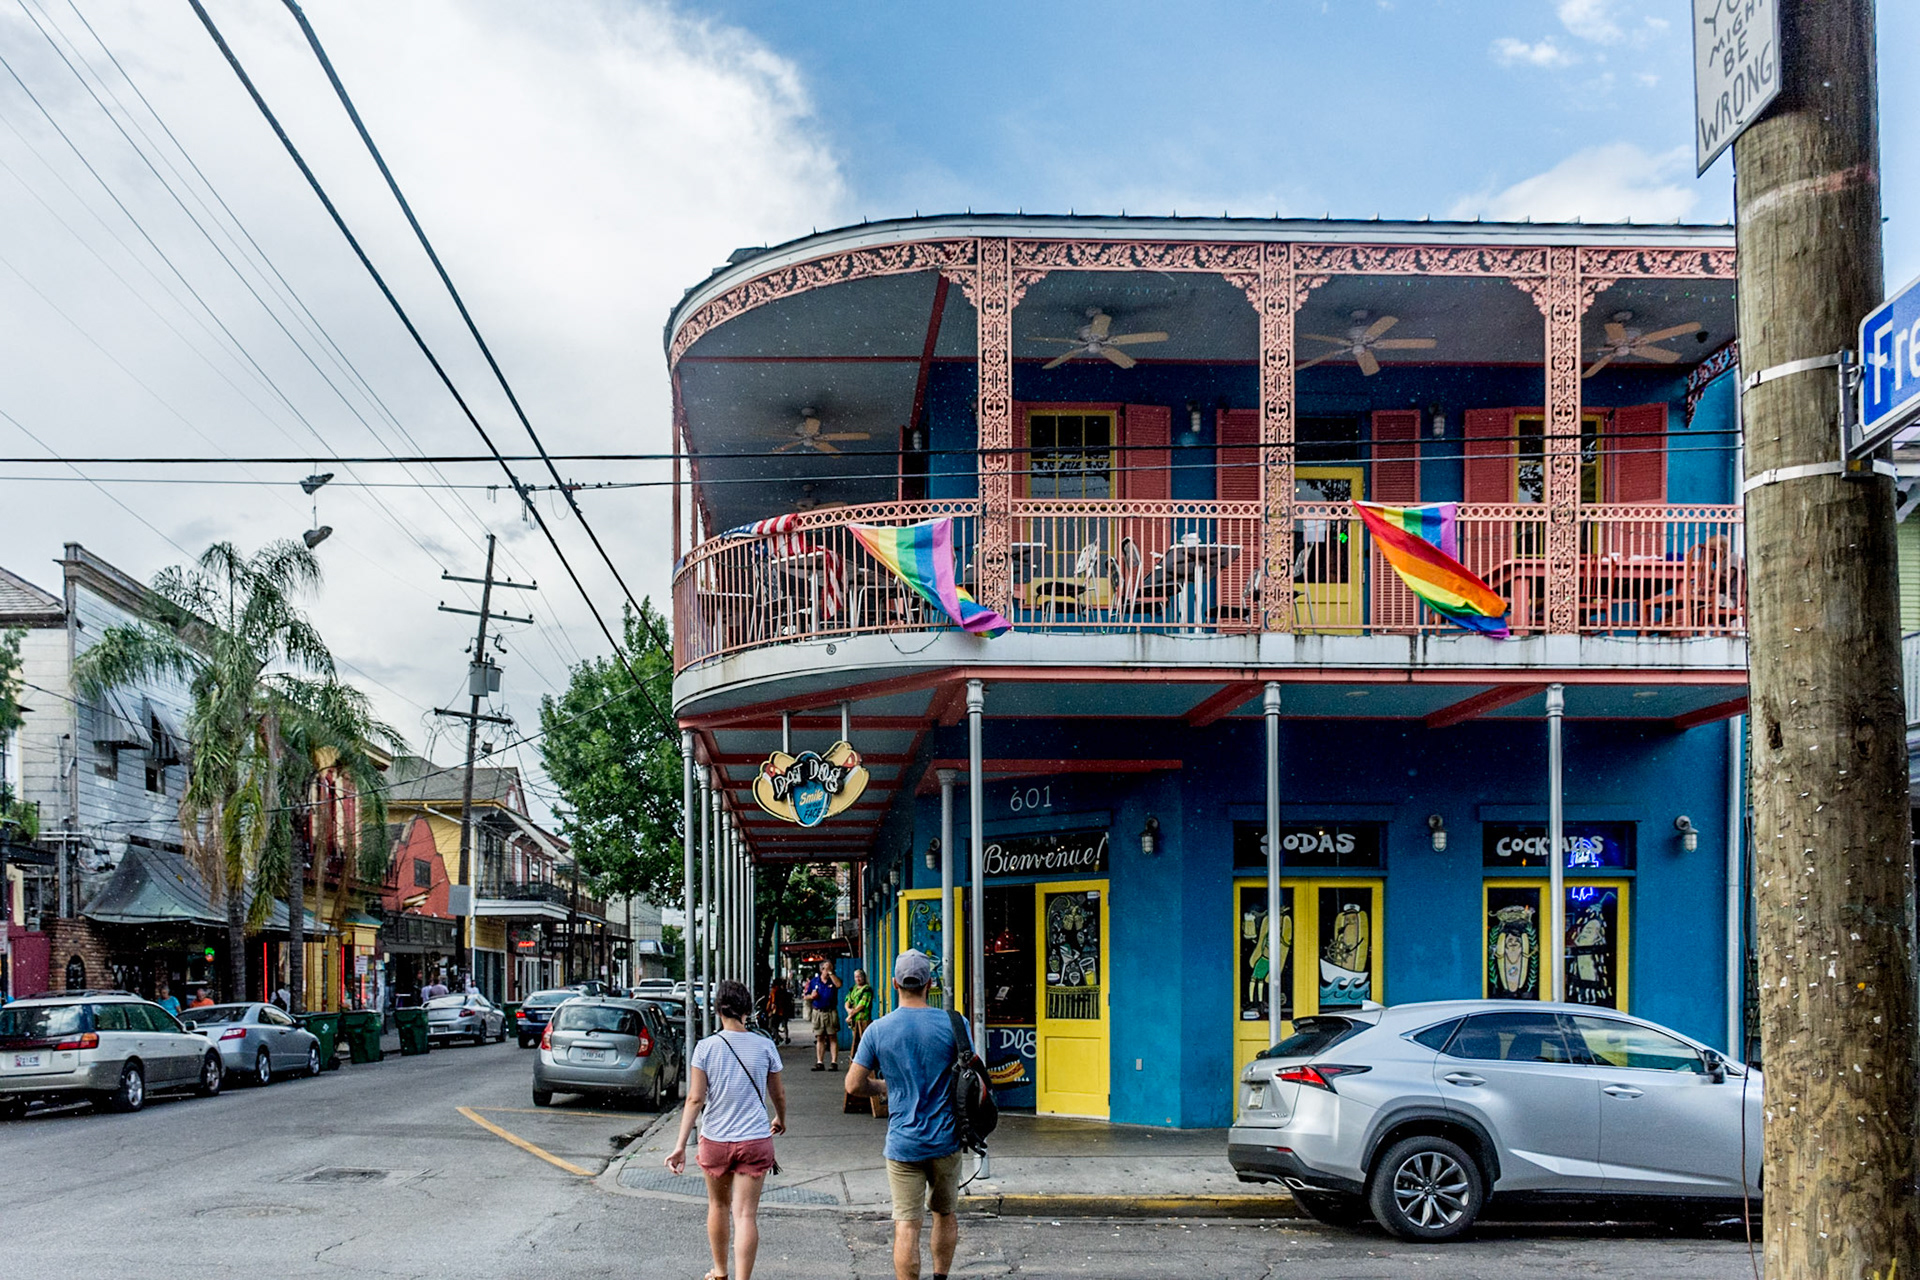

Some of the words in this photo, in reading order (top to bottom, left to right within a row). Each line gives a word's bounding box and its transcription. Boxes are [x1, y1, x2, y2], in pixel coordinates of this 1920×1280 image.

[1709, 0, 1763, 68] MIGH
[1723, 29, 1750, 78] BE
[1700, 40, 1773, 152] WRONG
[799, 788, 824, 806] Smile
[1010, 785, 1052, 811] 601
[803, 807, 823, 820] FACE
[1496, 835, 1604, 857] COCKAILS
